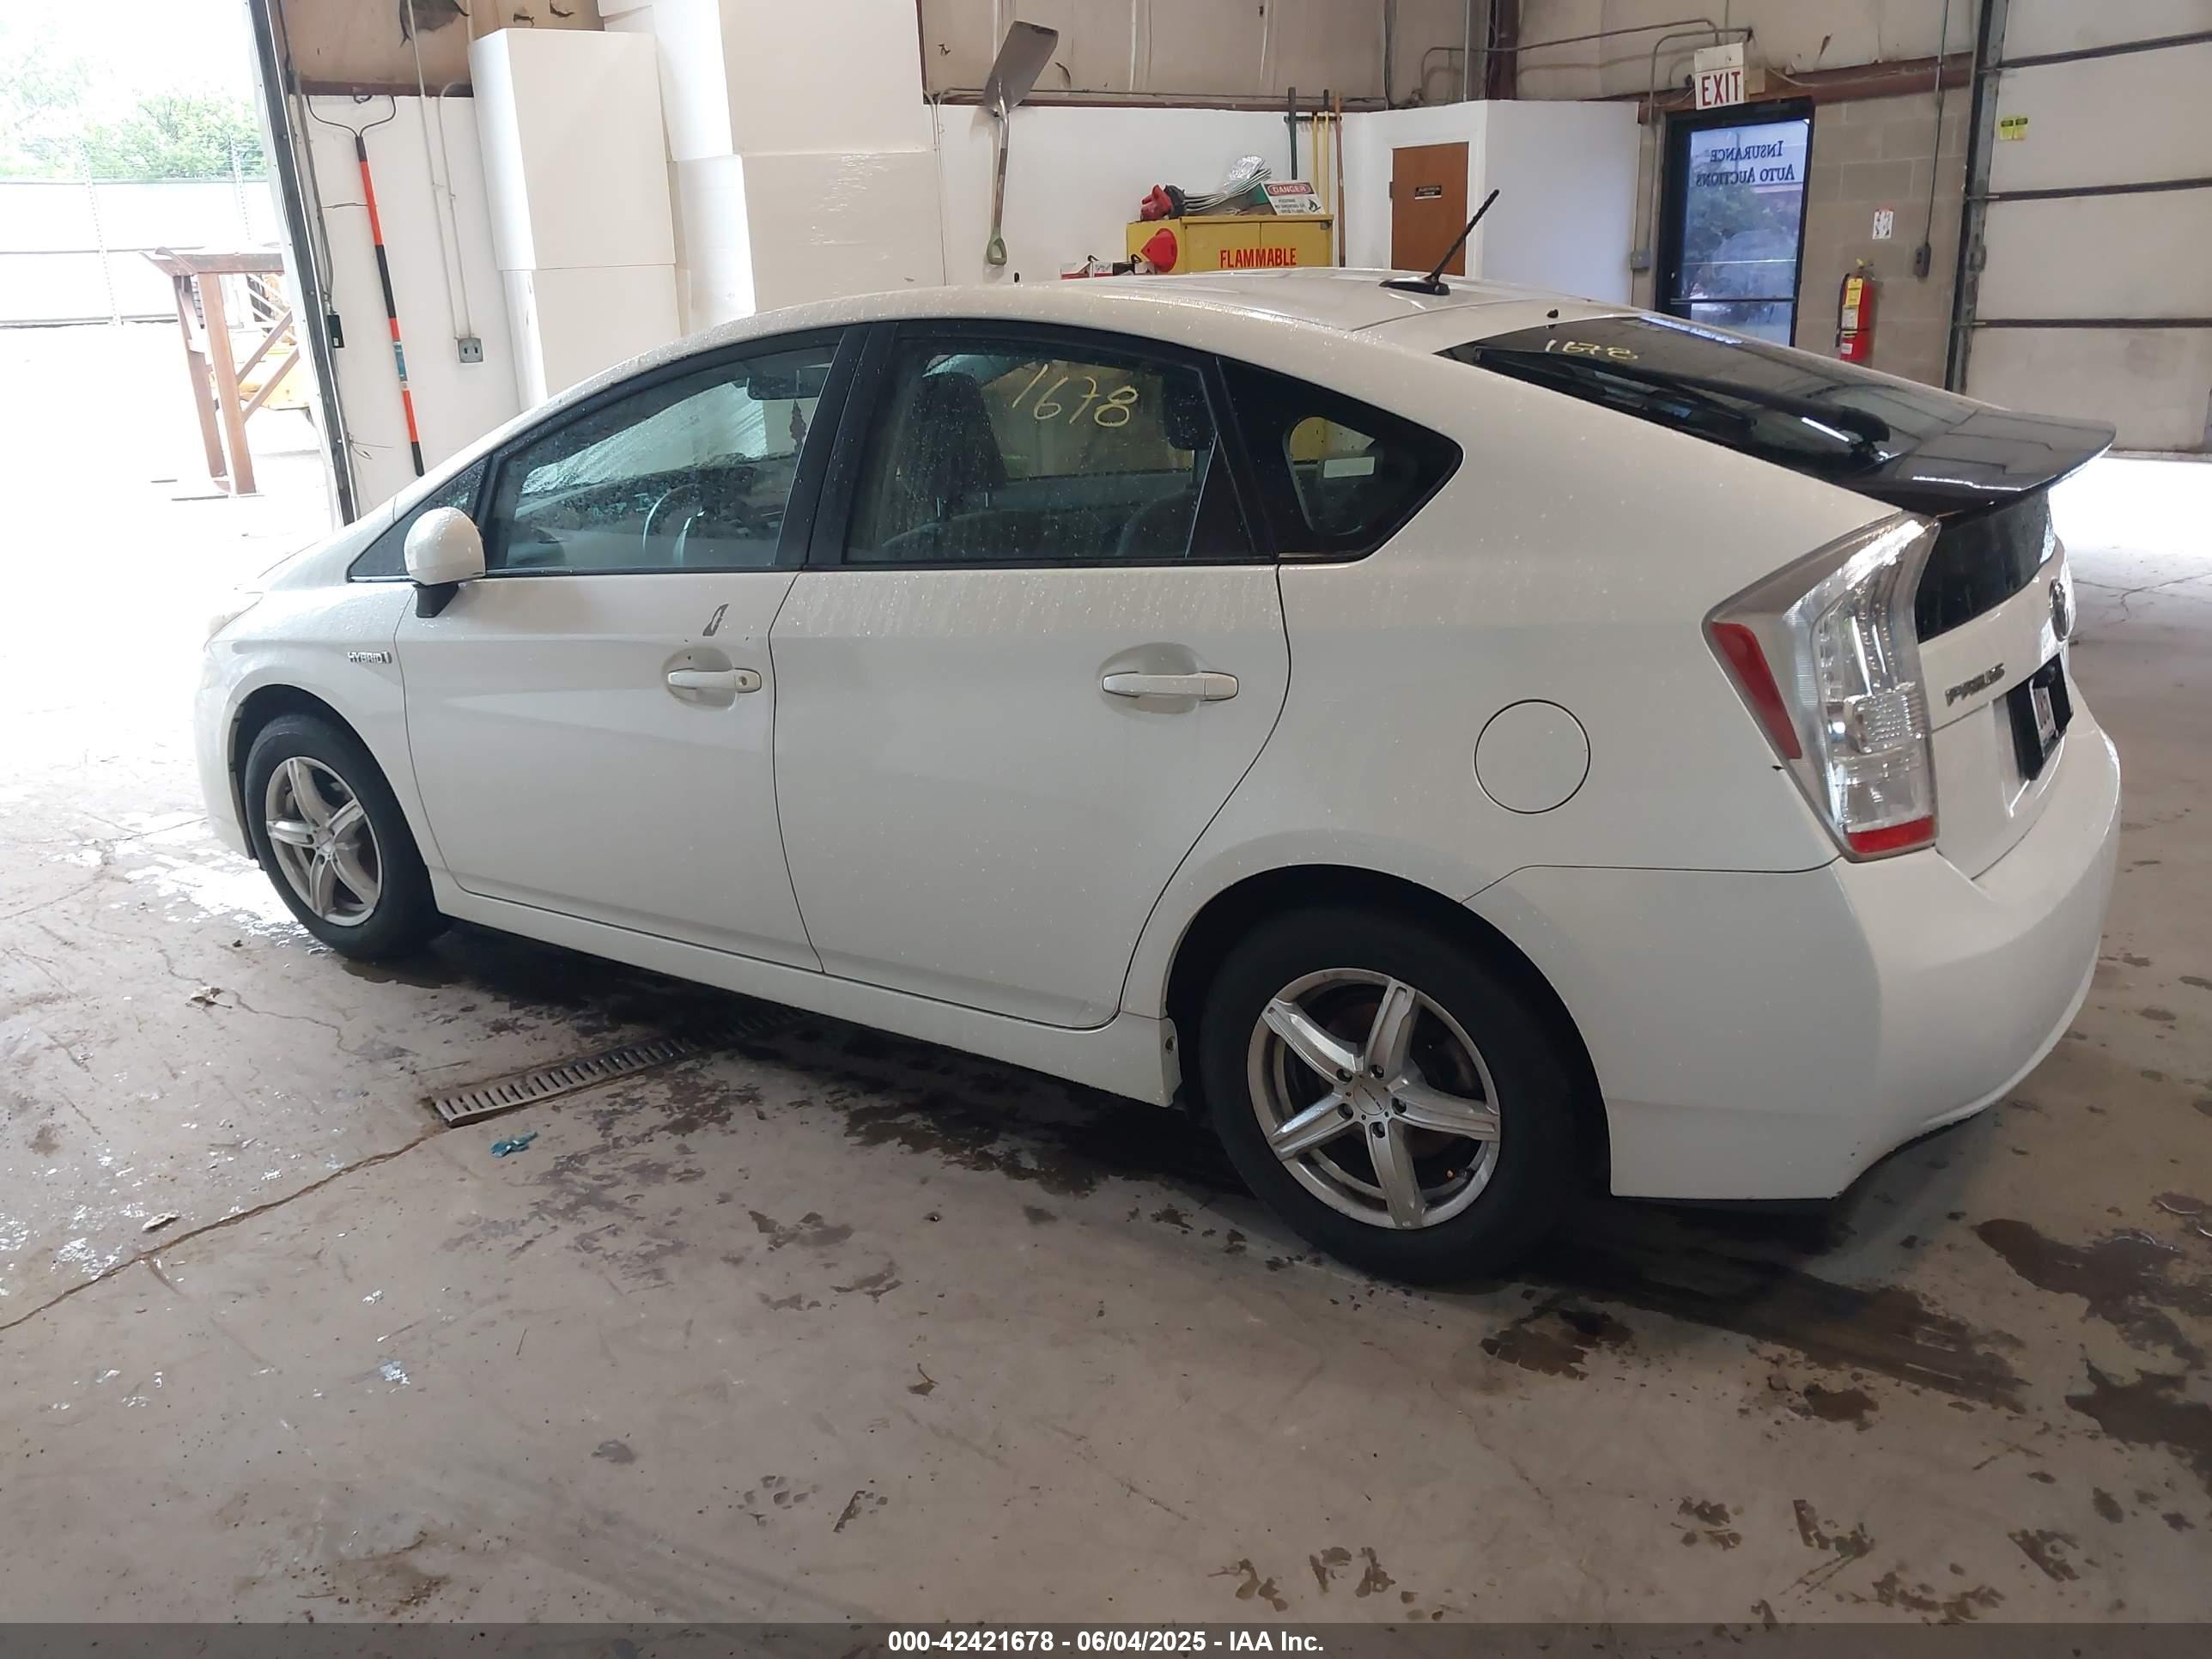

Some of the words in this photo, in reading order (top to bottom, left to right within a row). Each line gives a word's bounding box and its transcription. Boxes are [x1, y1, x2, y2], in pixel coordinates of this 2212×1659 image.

[1701, 71, 1741, 106] EXIT
[1273, 184, 1307, 193] DANGER
[1219, 247, 1297, 269] FLAMMABLE
[1545, 339, 1638, 360] 1678
[1012, 362, 1139, 428] 1678
